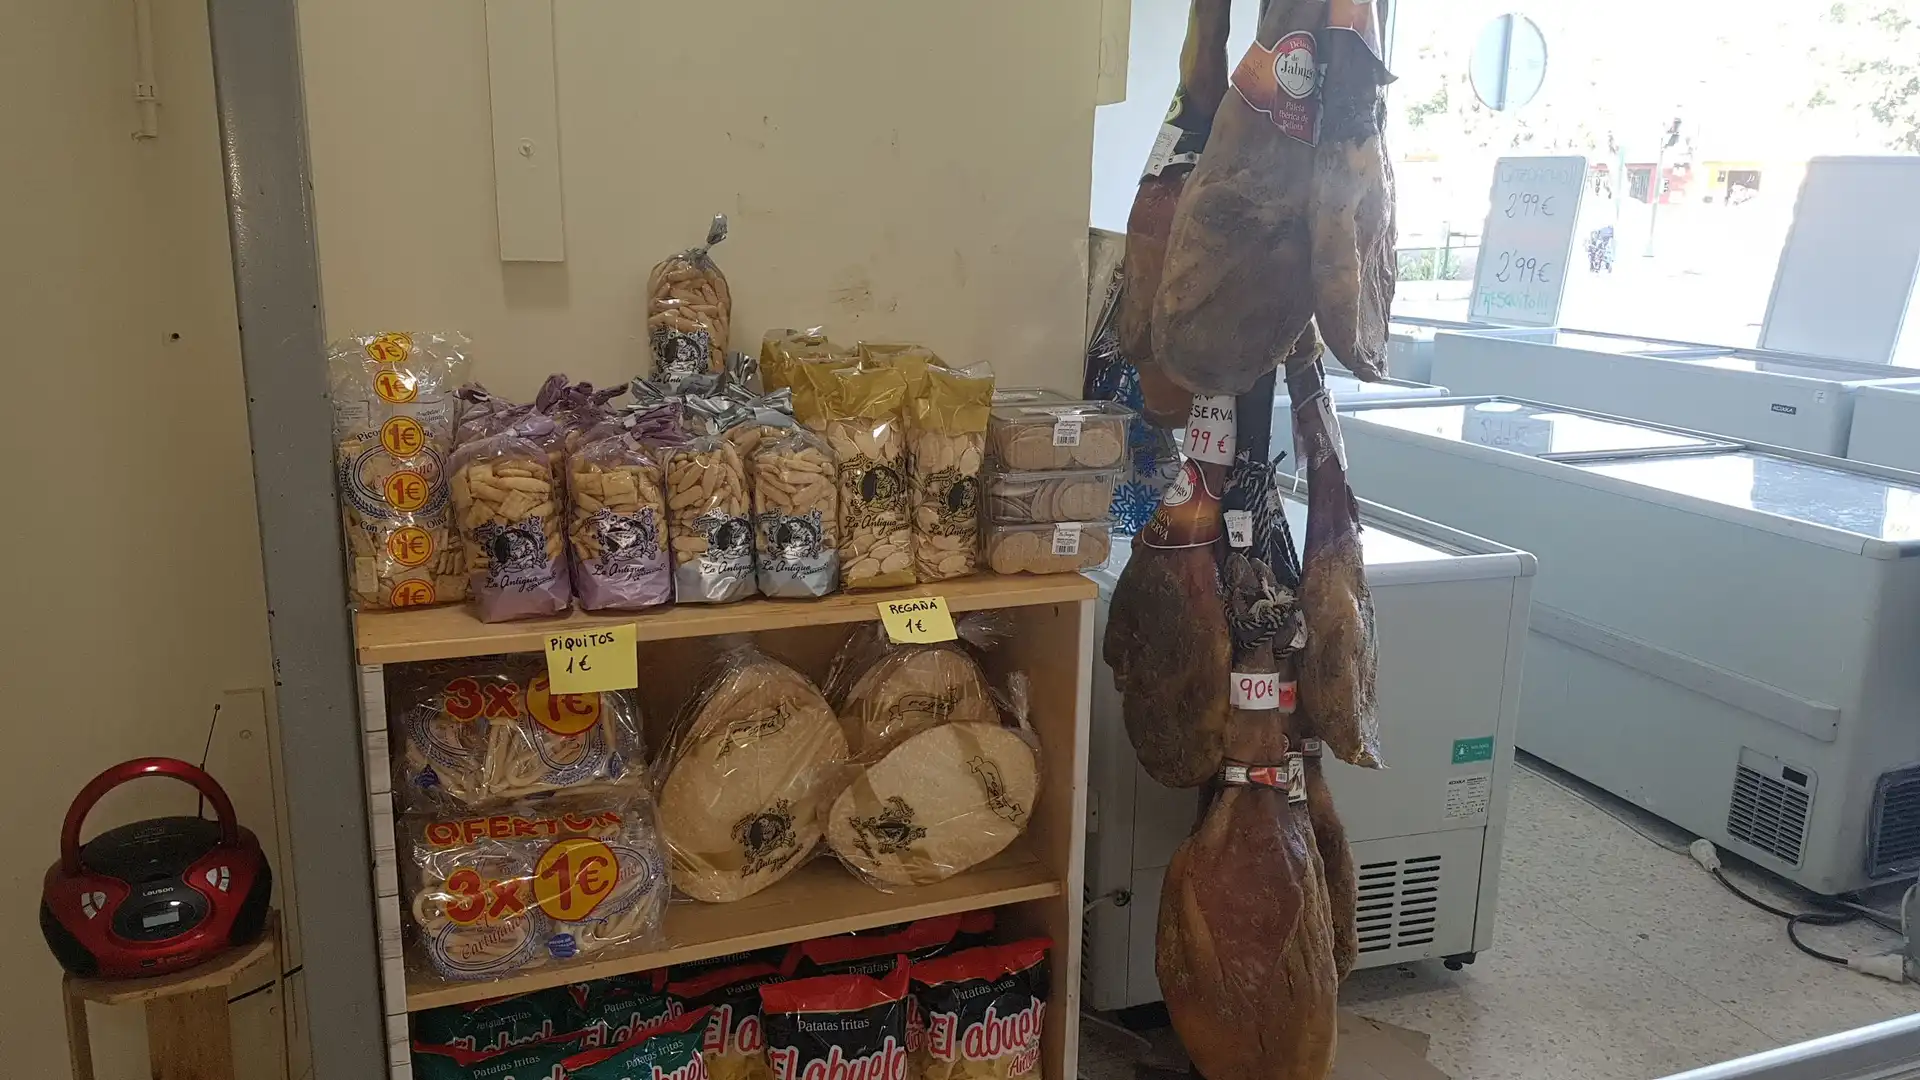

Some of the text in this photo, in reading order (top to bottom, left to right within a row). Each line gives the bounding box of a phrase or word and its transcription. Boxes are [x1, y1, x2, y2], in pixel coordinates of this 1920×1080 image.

[662, 372, 682, 384] Anti
[388, 423, 417, 451] 1€
[393, 478, 421, 505] 1€
[360, 520, 378, 534] Con
[844, 515, 859, 528] La
[861, 514, 897, 536] Antigua
[928, 523, 943, 536] La
[395, 532, 425, 560] 1€
[591, 563, 606, 576] La
[700, 563, 716, 575] La
[762, 559, 776, 571] La
[776, 559, 811, 579] Antigua
[484, 577, 498, 588] La
[500, 574, 538, 593] Antigua
[905, 617, 927, 635] 1€
[565, 654, 592, 674] 1€
[741, 864, 754, 879] La
[540, 852, 609, 912] 1€
[848, 961, 889, 976] Patatas
[797, 1017, 870, 1033] Patatas fritas
[928, 1010, 958, 1063] El
[658, 1039, 685, 1056] fritas
[473, 1062, 512, 1080] Patatas
[513, 1055, 541, 1069] fritas
[768, 1045, 800, 1080] El
